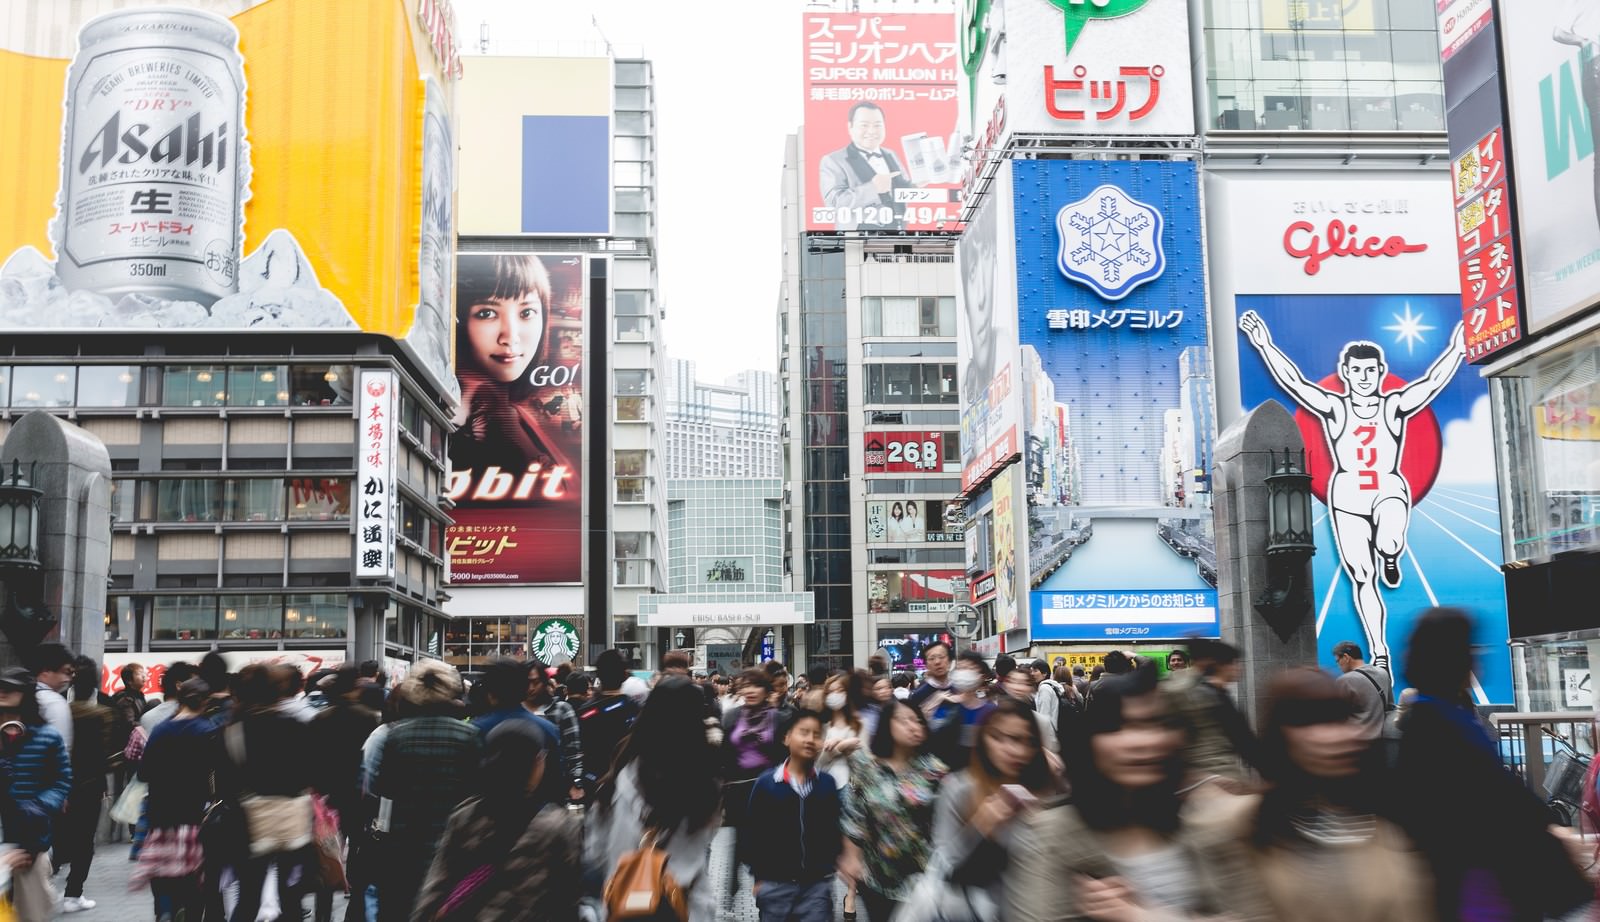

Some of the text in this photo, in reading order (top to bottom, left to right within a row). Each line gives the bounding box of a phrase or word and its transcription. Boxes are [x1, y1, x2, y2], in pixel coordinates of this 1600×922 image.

[809, 17, 906, 38] スーパー
[810, 42, 956, 64] ミリオンヘア
[100, 61, 214, 98] ASAHI BREWERIES LIMITED
[810, 68, 867, 80] SUPER
[873, 69, 936, 81] MILLION
[811, 88, 959, 101] 薄毛部分のボリュームア
[1044, 65, 1165, 121] ピップ
[79, 110, 227, 175] Asahi
[130, 189, 172, 214] 生
[109, 220, 194, 235] スーパードライ
[1481, 131, 1512, 321] インターネット
[1283, 218, 1428, 276] Glico
[130, 264, 166, 276] 350ml
[1464, 229, 1488, 335] コミック
[1046, 309, 1183, 329] 雪印メグミルク
[529, 364, 580, 386] GO!
[367, 402, 384, 468] 本場の味
[887, 441, 937, 463] 268
[1353, 422, 1379, 490] グリコ
[446, 535, 518, 555] ビット
[1052, 594, 1205, 609] 雪印メグミルクからのお知らせ
[1104, 627, 1150, 635] 雪印メグミルク
